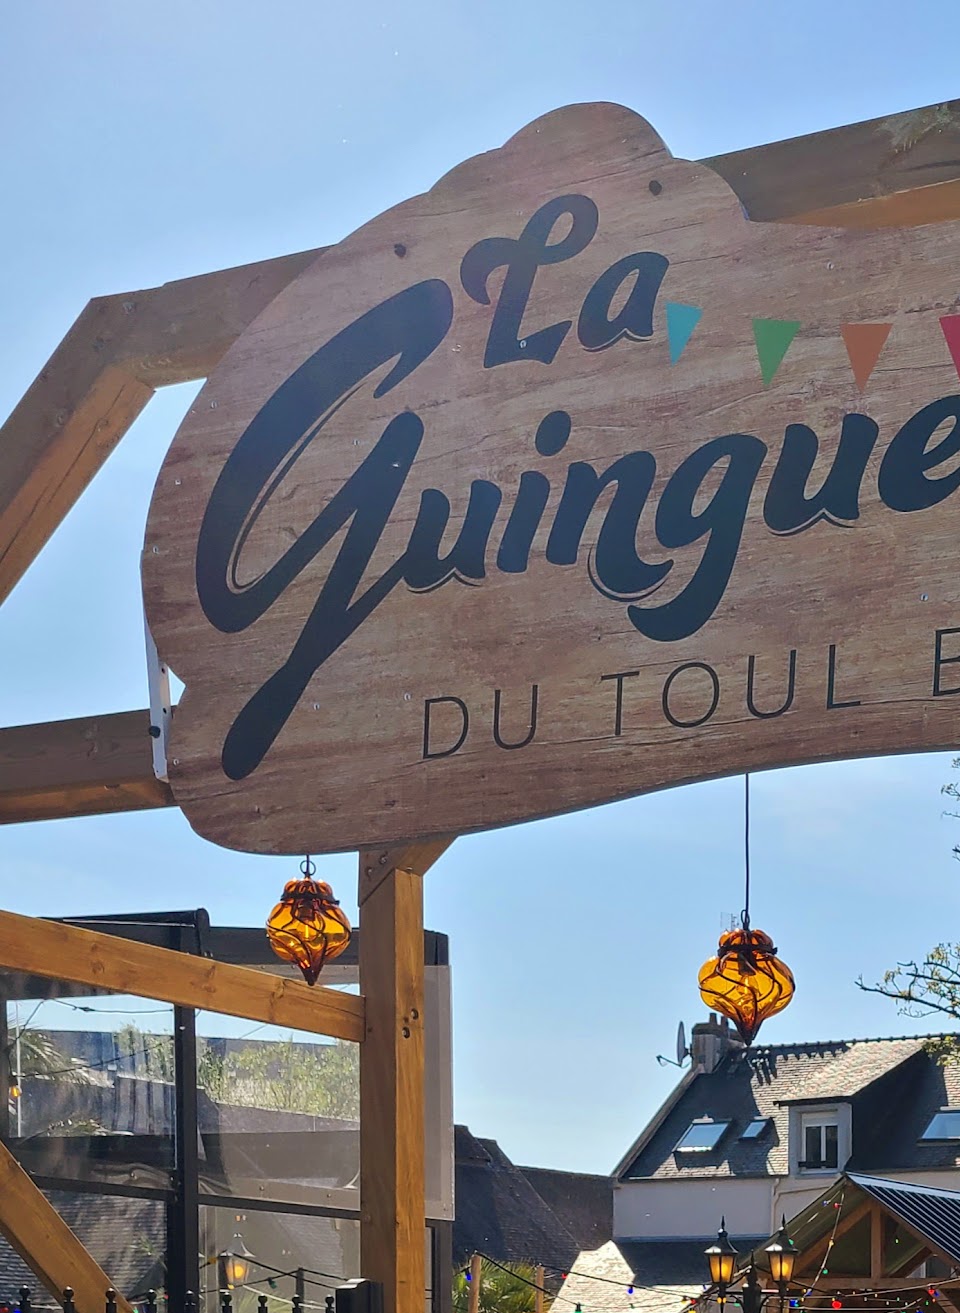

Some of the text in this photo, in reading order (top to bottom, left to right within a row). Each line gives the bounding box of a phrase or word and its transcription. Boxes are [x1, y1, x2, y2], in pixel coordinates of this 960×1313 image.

[459, 194, 671, 370] La
[423, 682, 539, 761] DU
[600, 643, 864, 739] TOUL
